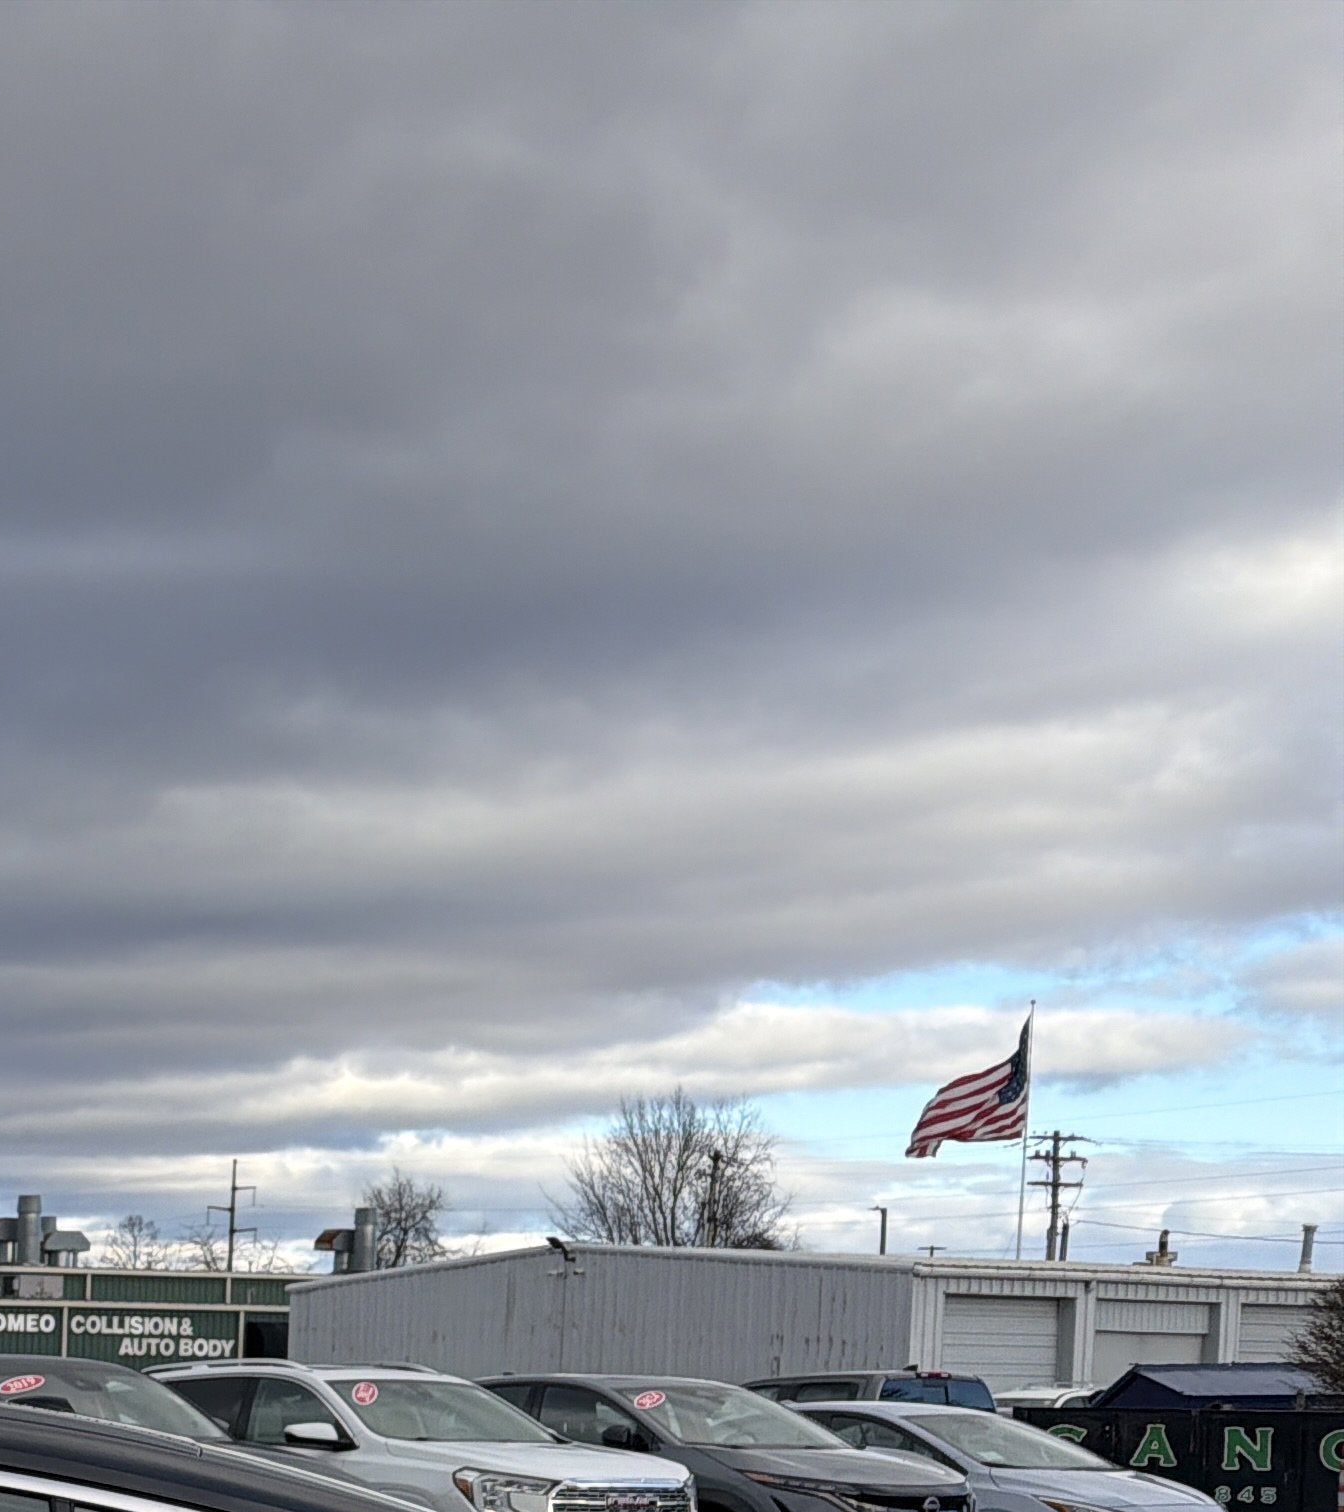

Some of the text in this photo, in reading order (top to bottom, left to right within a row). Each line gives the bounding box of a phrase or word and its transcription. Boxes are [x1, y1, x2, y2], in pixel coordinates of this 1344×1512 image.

[70, 1315, 178, 1336] COLLISION
[118, 1337, 236, 1357] AUTO BODY
